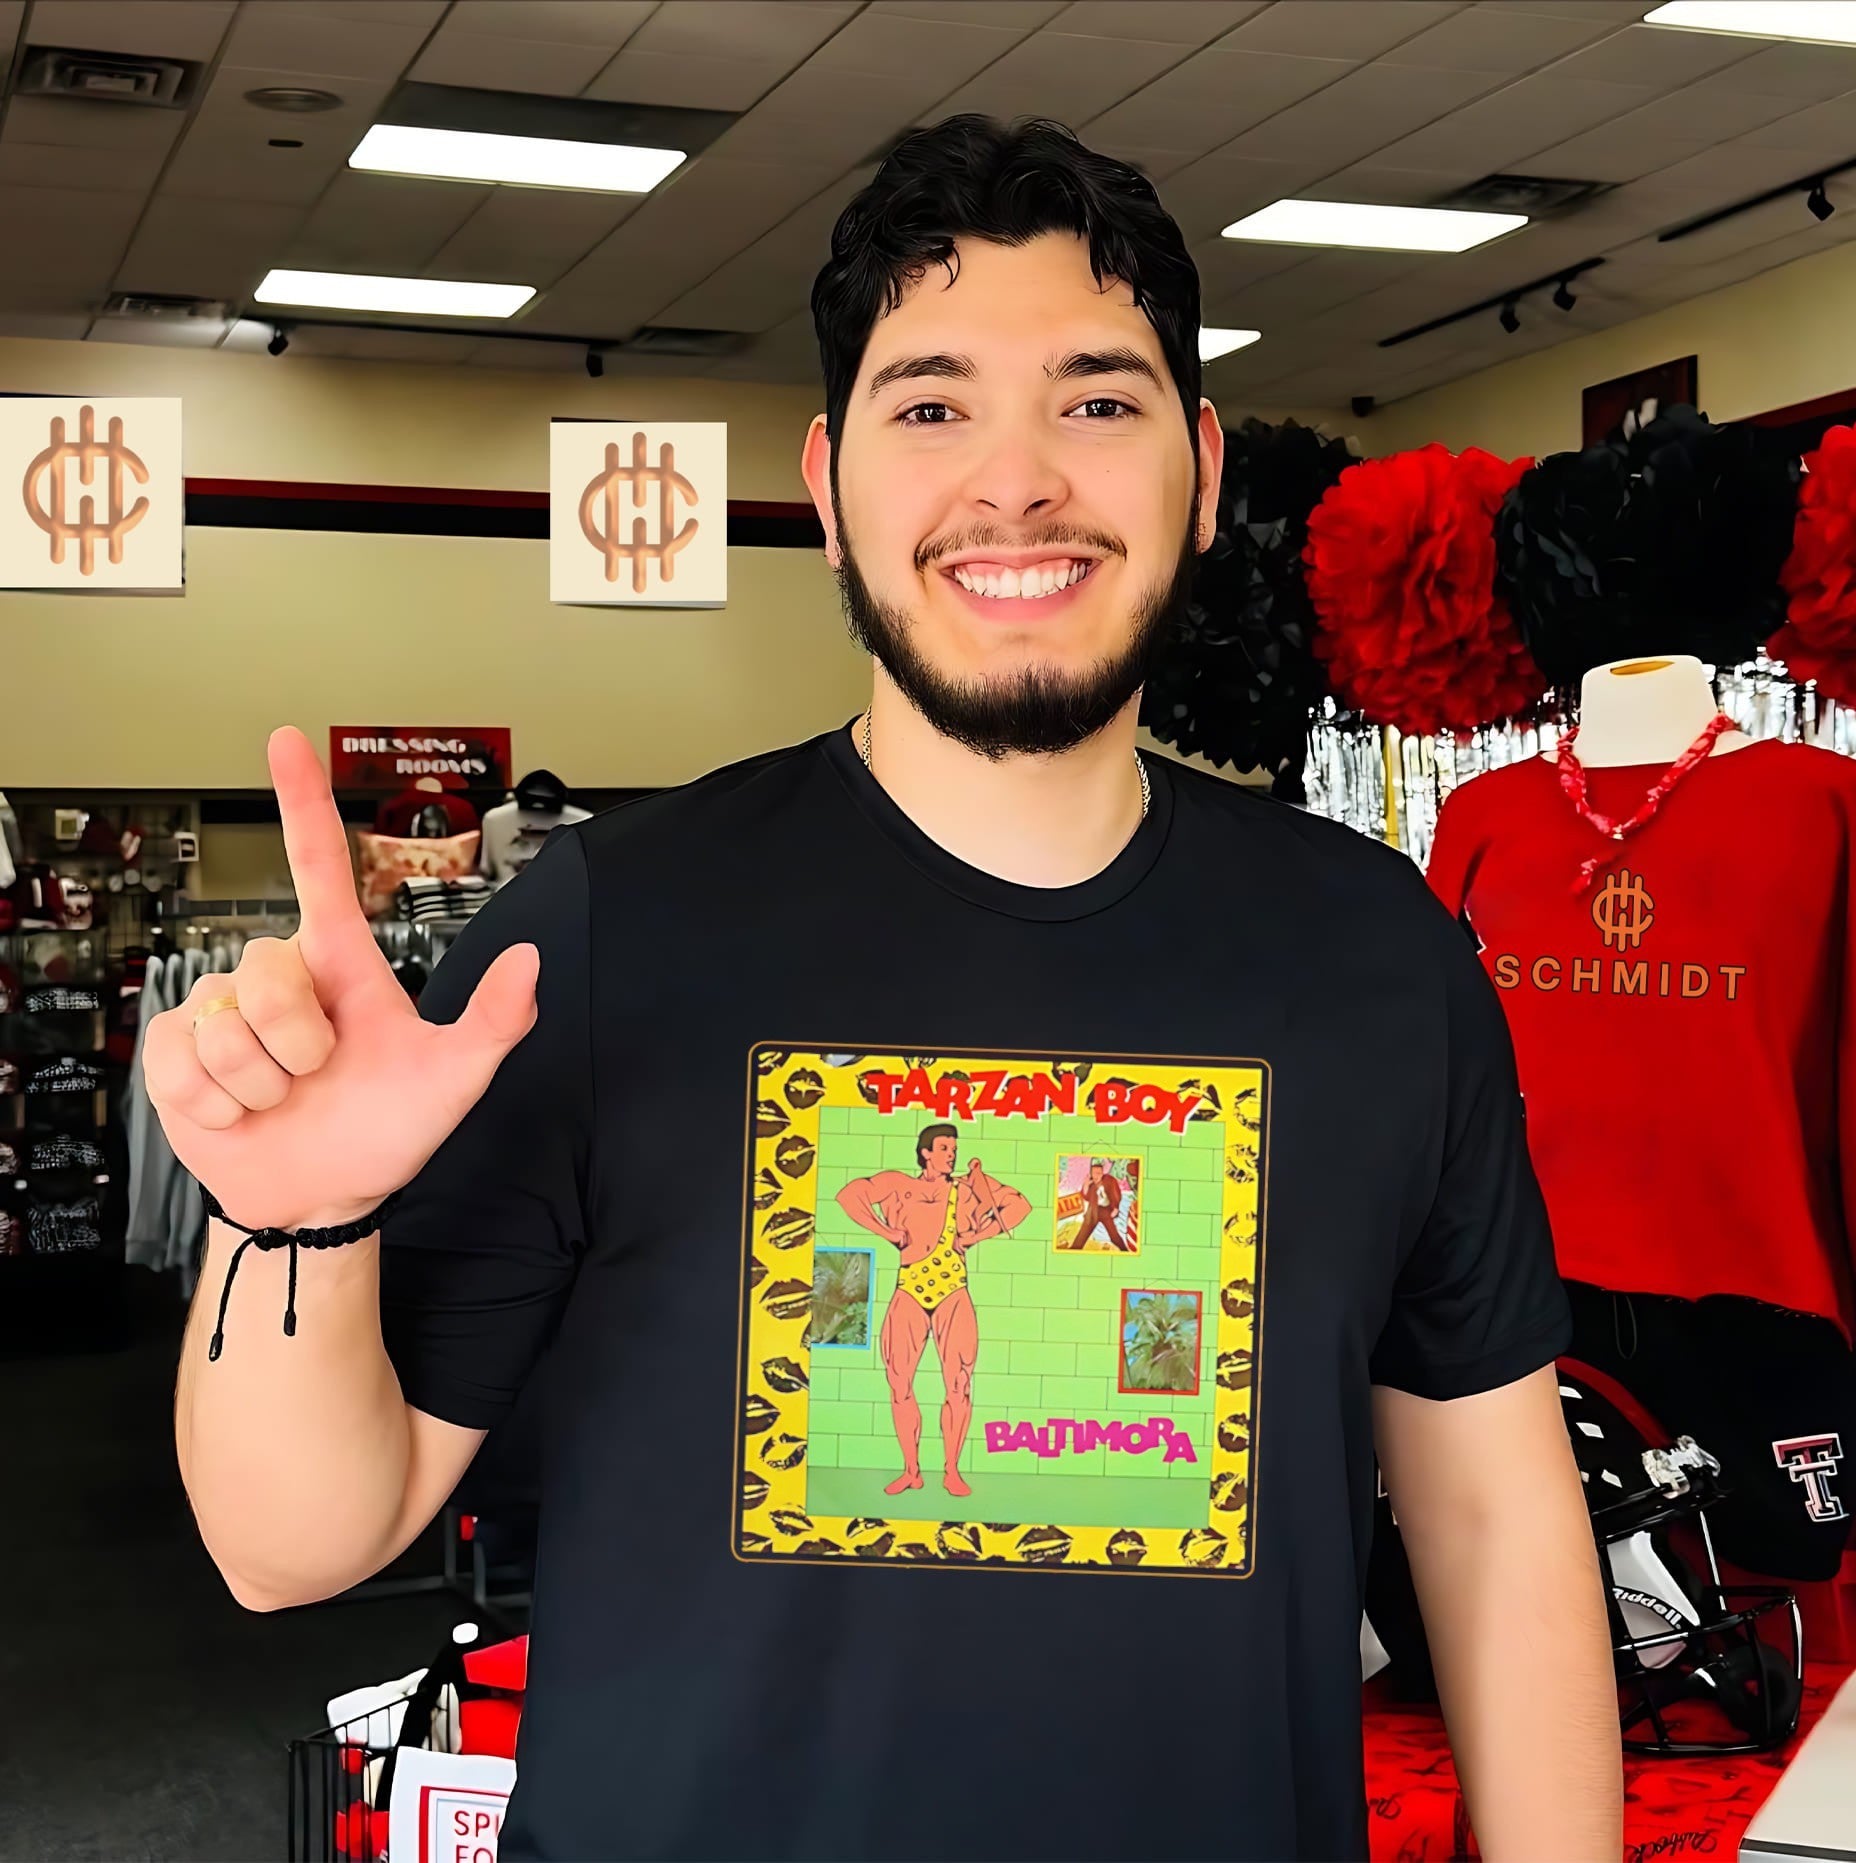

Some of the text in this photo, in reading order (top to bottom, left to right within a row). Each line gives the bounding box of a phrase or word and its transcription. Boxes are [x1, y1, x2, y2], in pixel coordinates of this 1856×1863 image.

[396, 758, 487, 774] ROOMS
[1494, 953, 1747, 1000] SCHMIDT
[866, 1068, 1203, 1136] TARZAN BOY
[984, 1416, 1199, 1464] BALTIMORA
